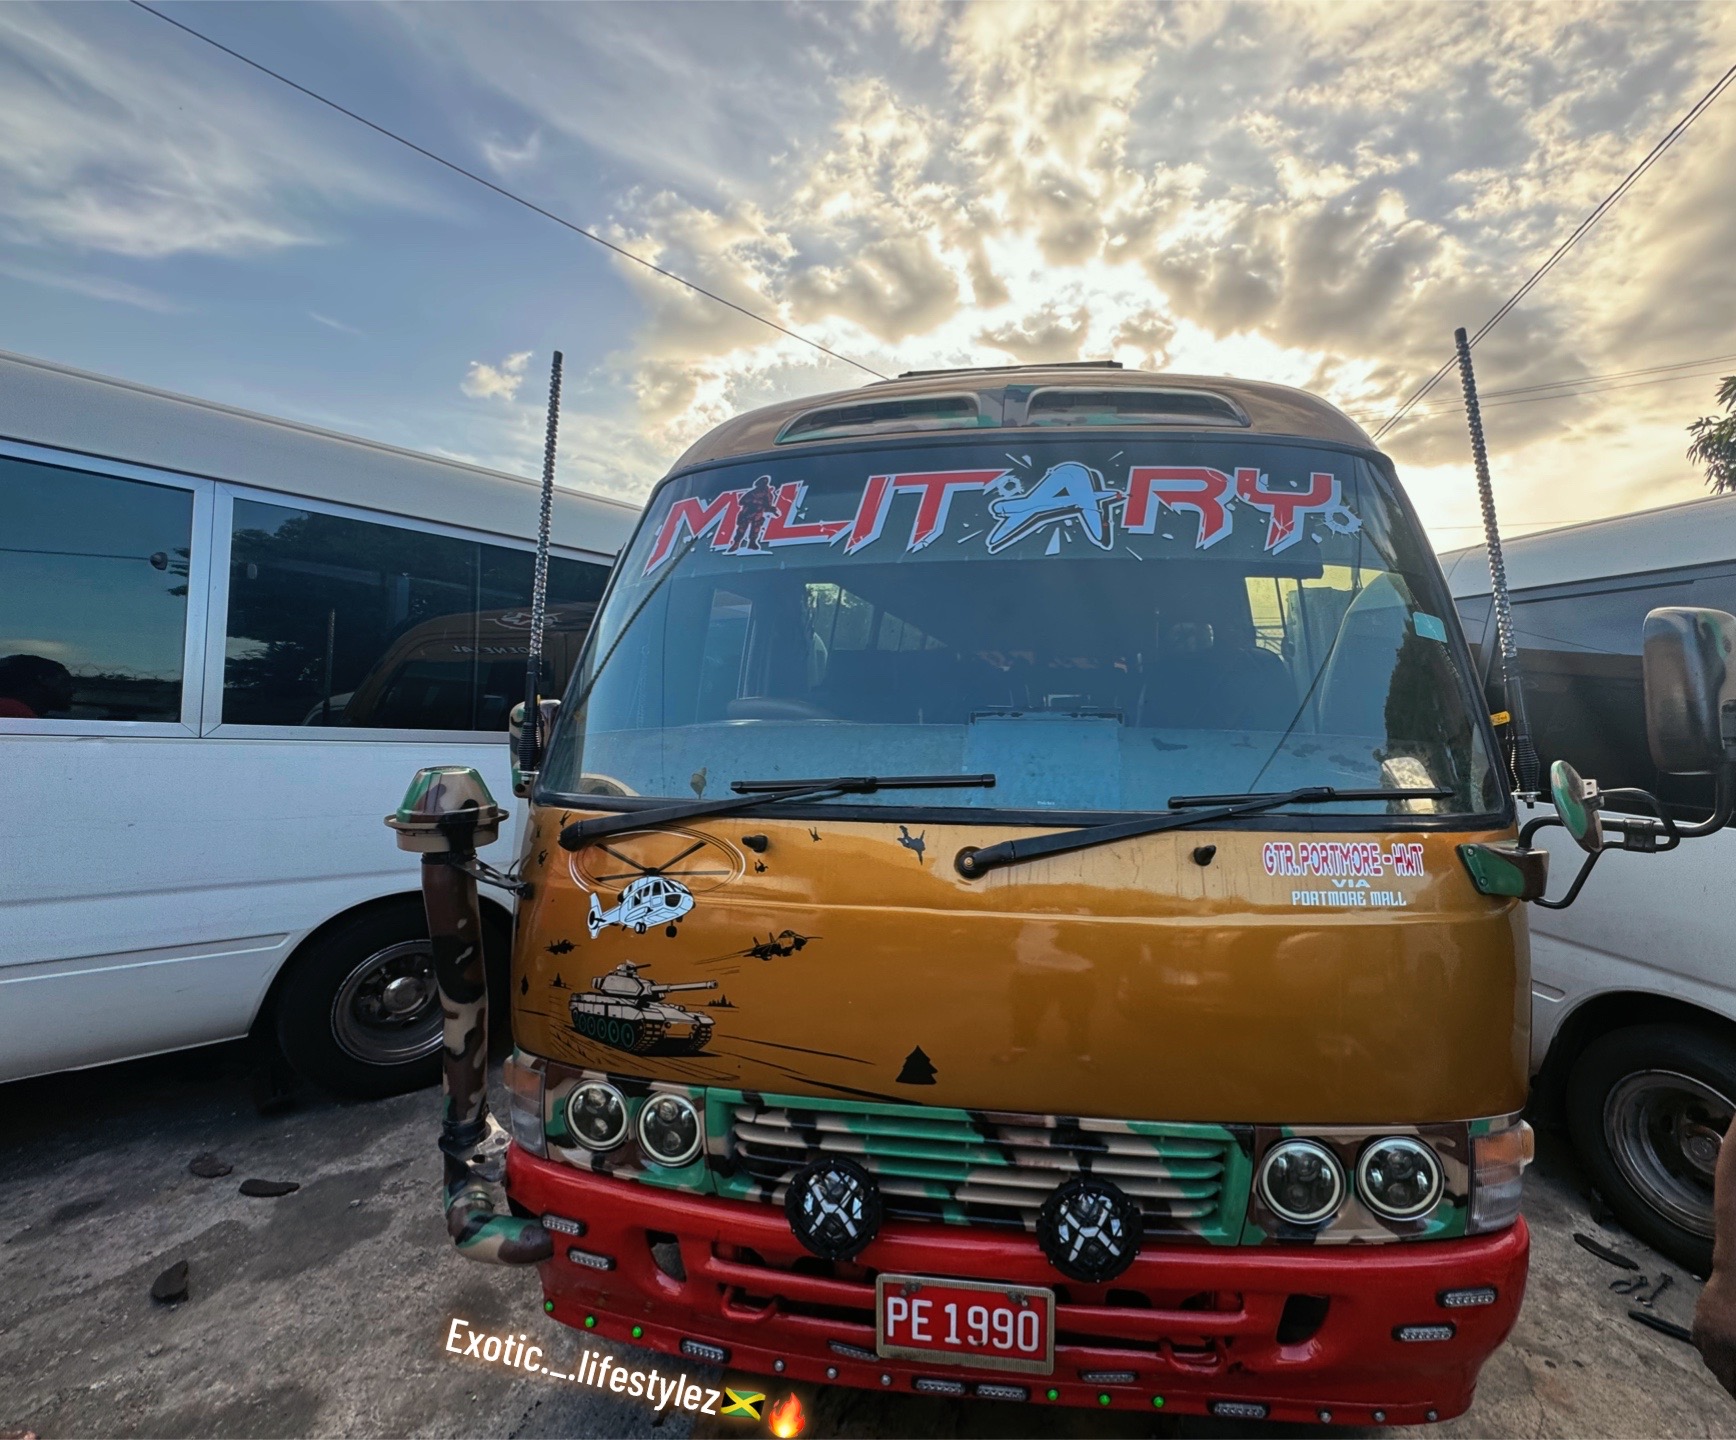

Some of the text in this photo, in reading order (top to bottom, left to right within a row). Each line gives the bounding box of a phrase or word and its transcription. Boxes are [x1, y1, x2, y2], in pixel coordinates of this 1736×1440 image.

[1331, 879, 1370, 888] VIA
[1291, 891, 1407, 906] PORTMORE MALL
[887, 1296, 1039, 1352] PE 1990
